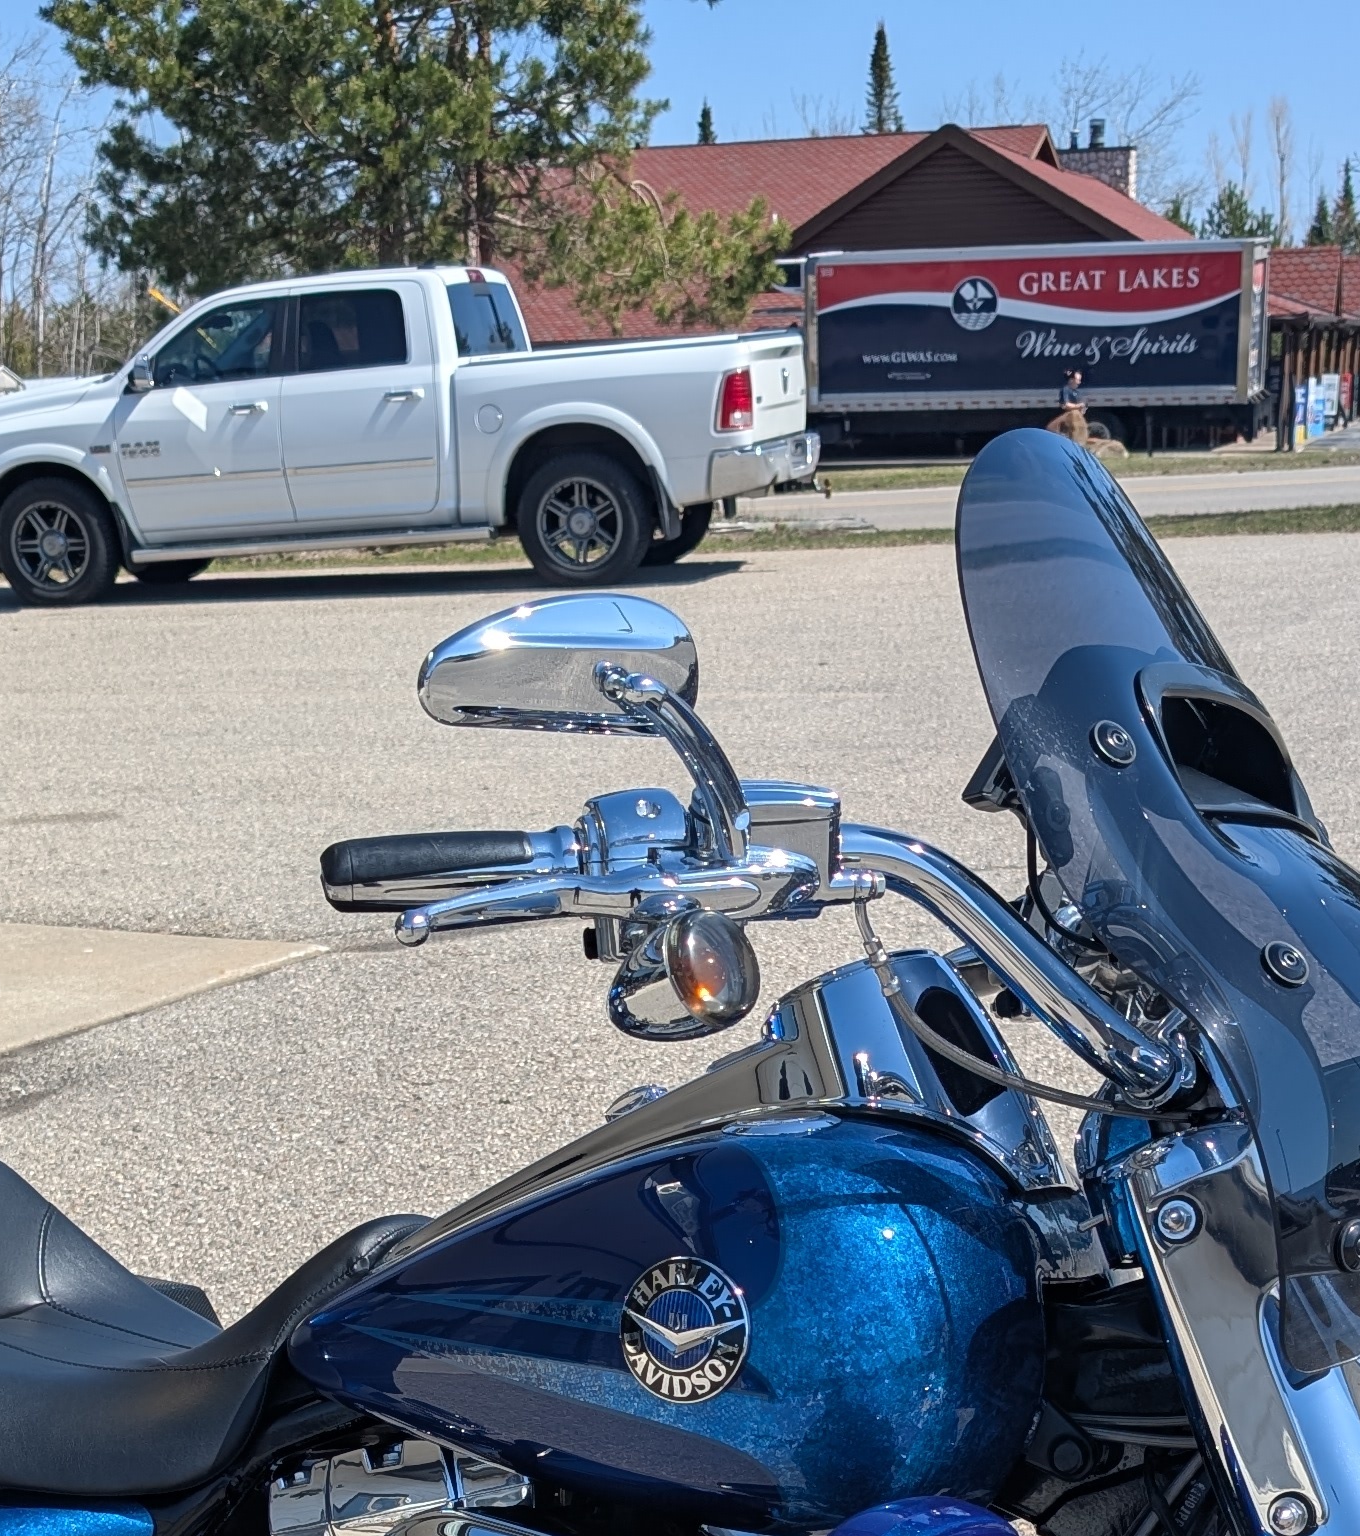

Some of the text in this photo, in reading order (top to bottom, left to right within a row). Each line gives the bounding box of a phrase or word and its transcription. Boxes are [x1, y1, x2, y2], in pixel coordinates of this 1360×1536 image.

[1019, 267, 1200, 295] GREAT LAKES
[1016, 327, 1198, 365] Wine & Spirits
[624, 1331, 740, 1398] DAVIDSON
